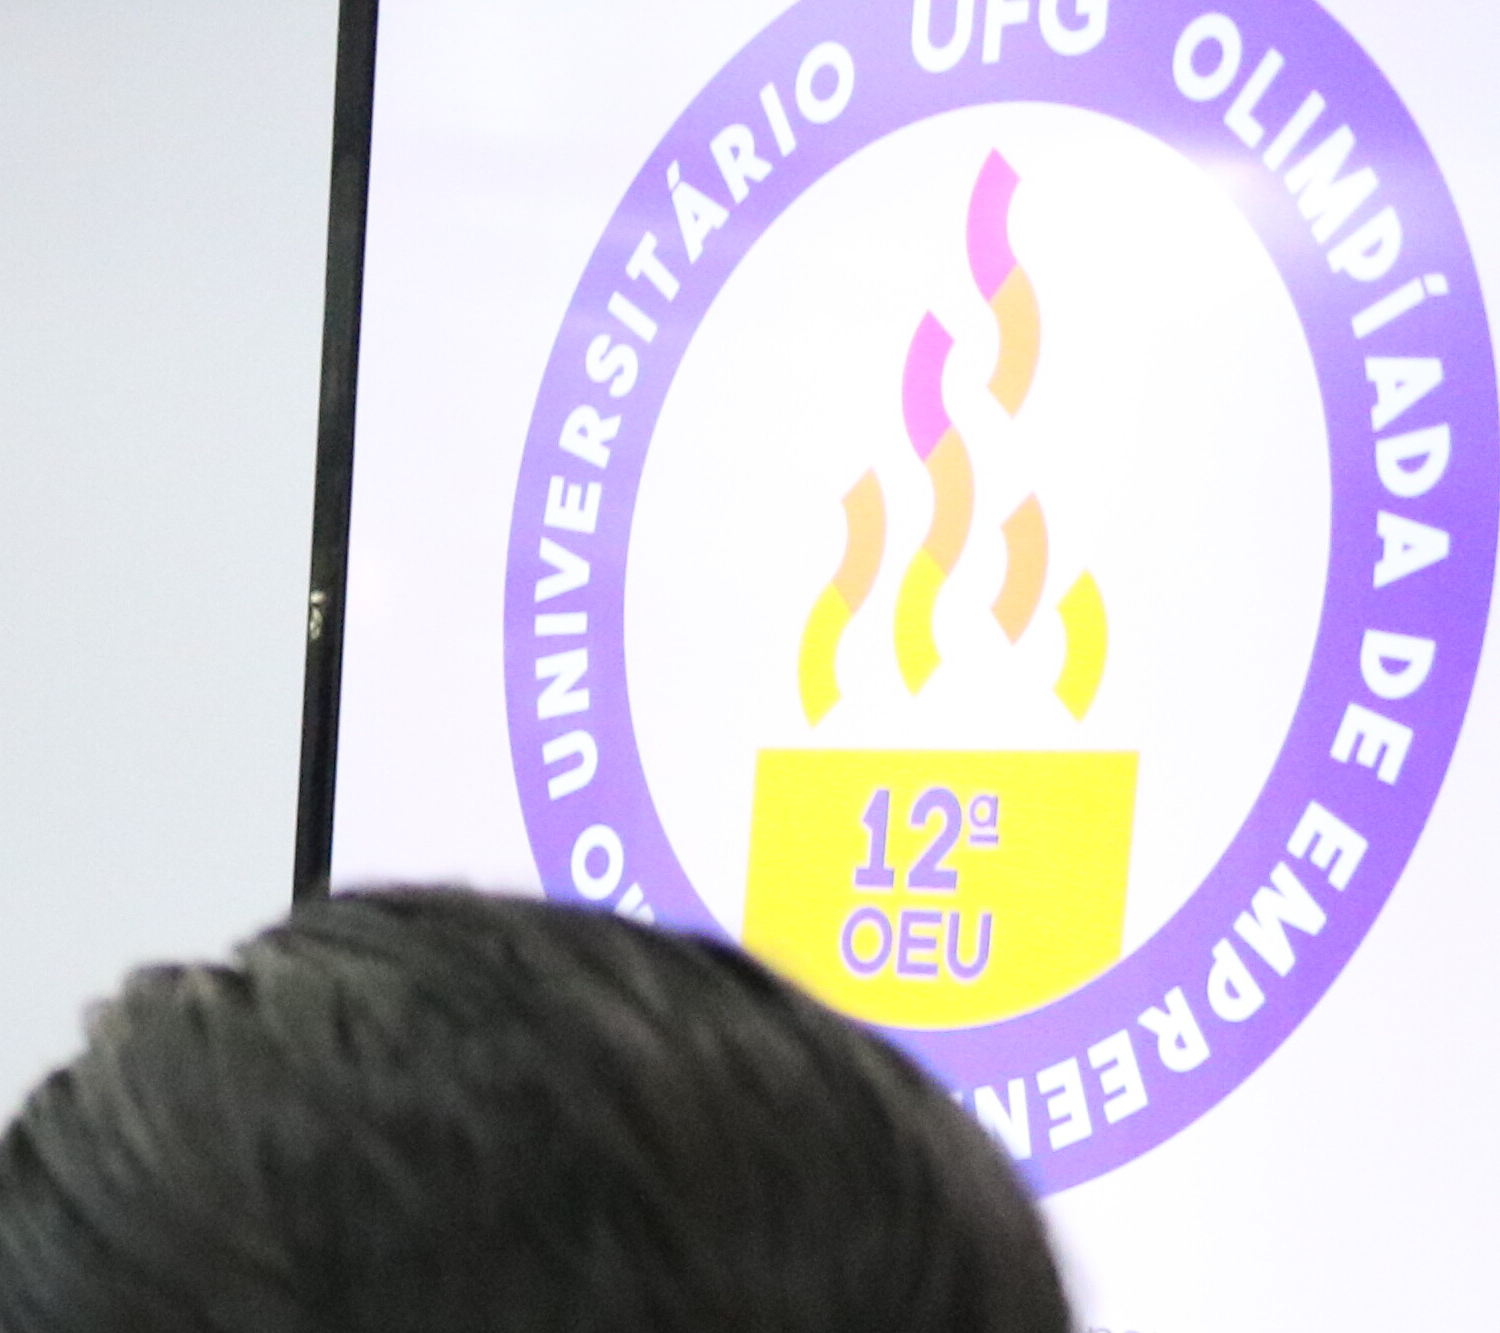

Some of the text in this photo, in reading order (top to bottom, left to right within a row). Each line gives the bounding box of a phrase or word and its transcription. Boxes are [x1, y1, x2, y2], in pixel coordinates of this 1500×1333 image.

[534, 0, 1451, 1160] UNIVERSITÁRIO UFG OLIMPÍADA DE EMPREEN
[841, 908, 993, 982] OEU
